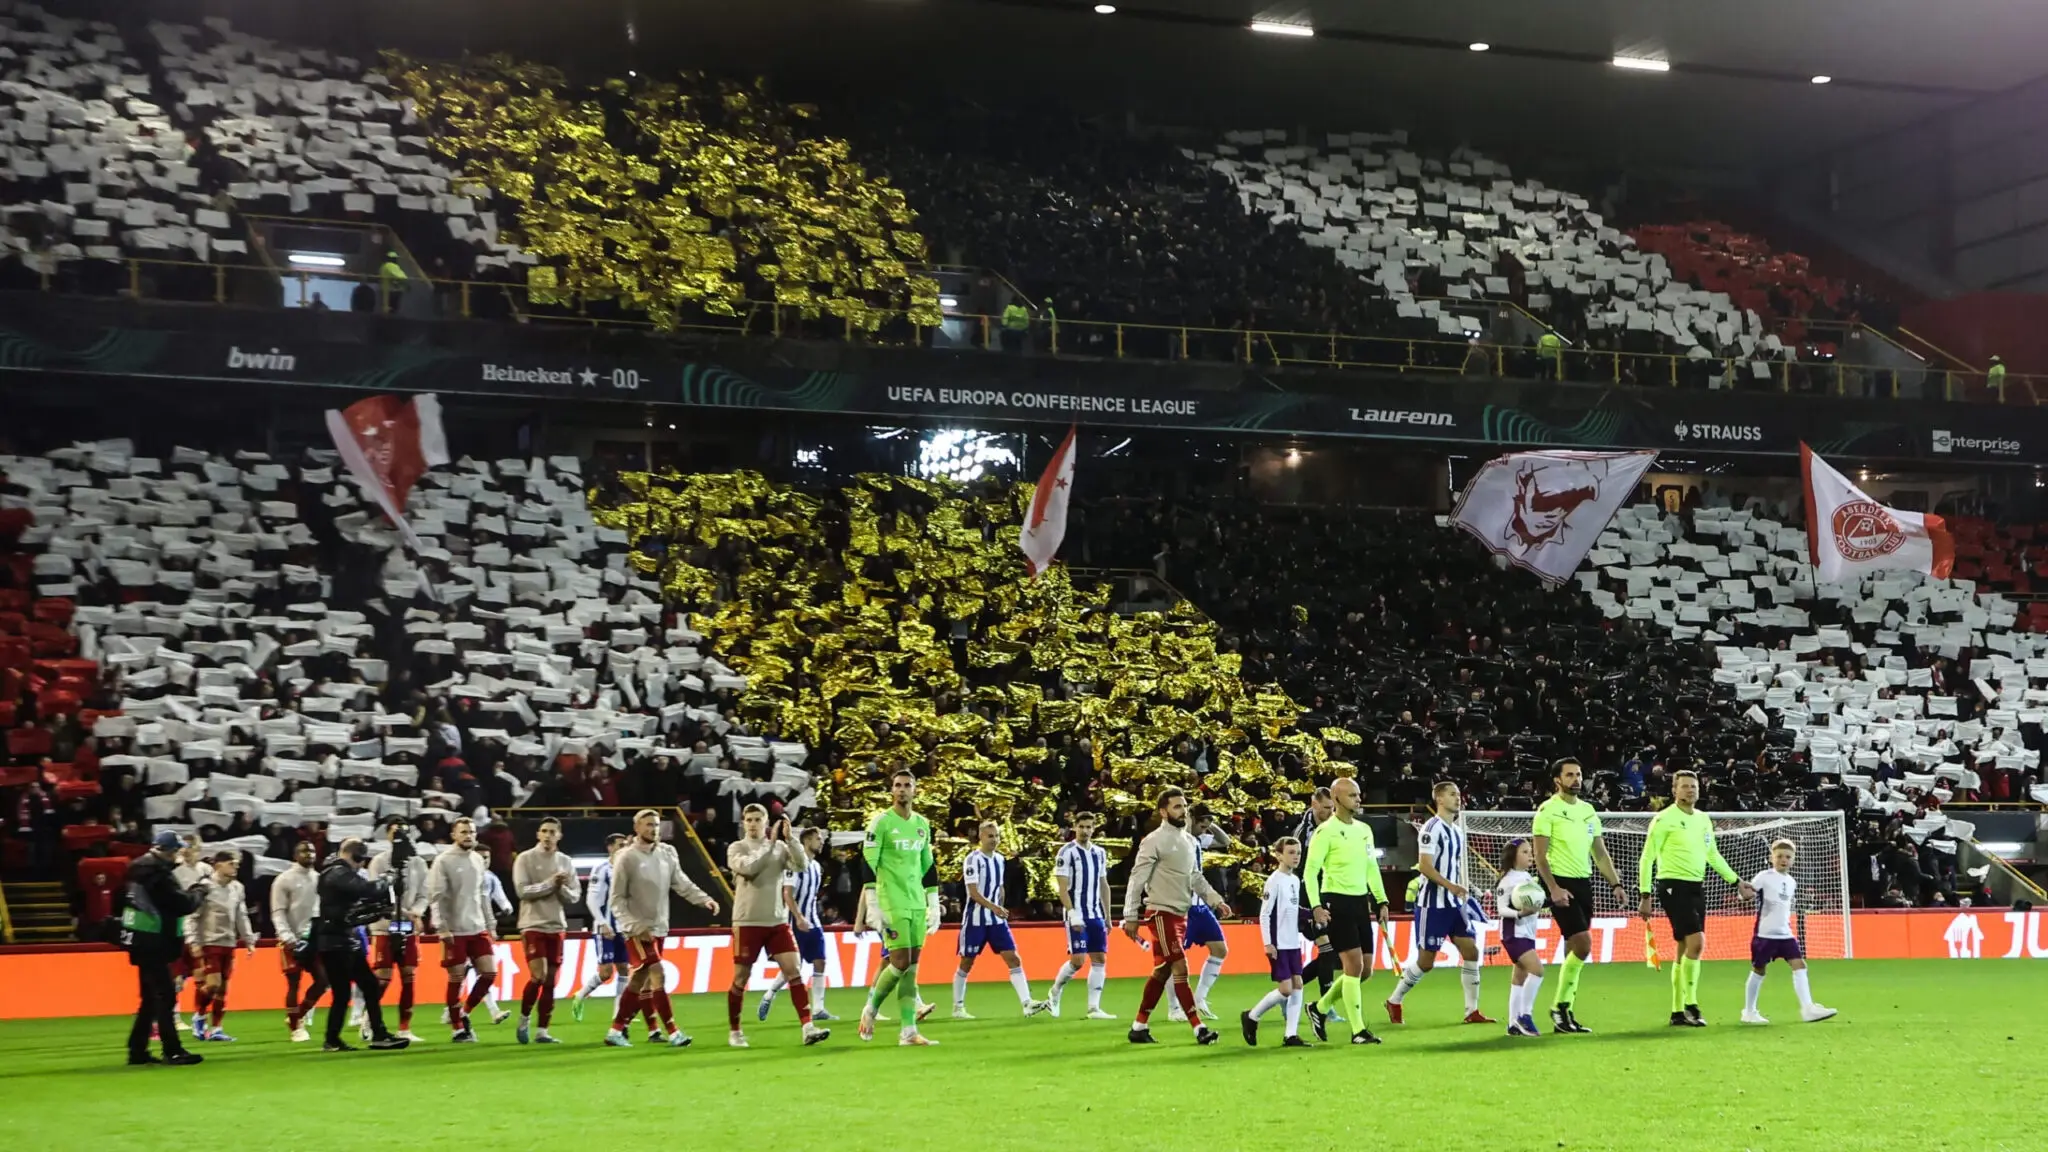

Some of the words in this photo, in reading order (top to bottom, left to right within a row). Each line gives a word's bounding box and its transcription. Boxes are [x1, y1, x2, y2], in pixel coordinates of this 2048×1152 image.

[227, 346, 296, 372] bwin
[482, 363, 573, 385] Heineken
[887, 386, 936, 403] UEFA
[939, 388, 1008, 406] EUROPA
[1011, 391, 1126, 413] CONFERENCE
[1131, 398, 1197, 415] LEAGUE
[1692, 423, 1762, 441] STRAUSS
[1933, 432, 2020, 452] enterprise
[1841, 504, 1893, 525] ABERDEEN
